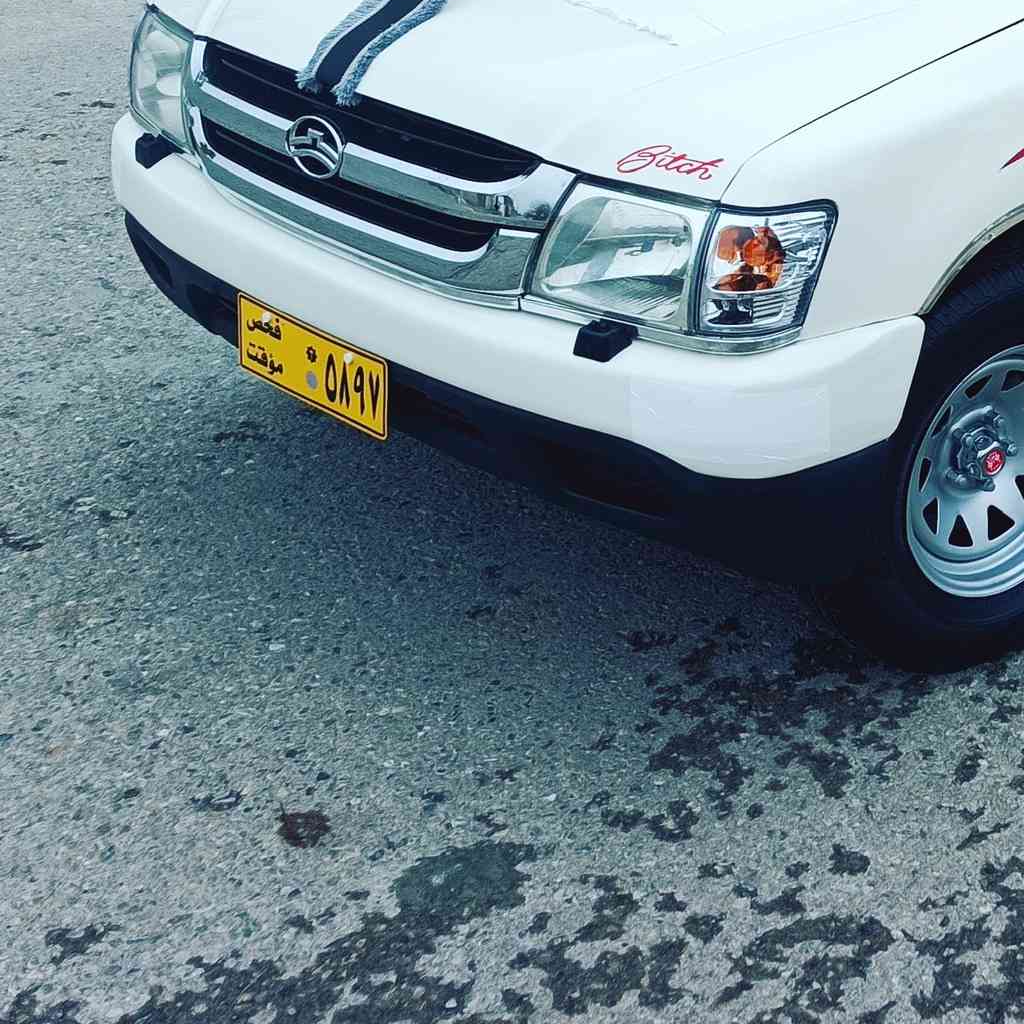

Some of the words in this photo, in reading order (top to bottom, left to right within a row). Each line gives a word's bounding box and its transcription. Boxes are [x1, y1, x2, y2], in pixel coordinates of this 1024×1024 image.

[617, 144, 724, 180] Bitch
[246, 317, 282, 341] فحص
[324, 352, 380, 421] ٥٨٩٧
